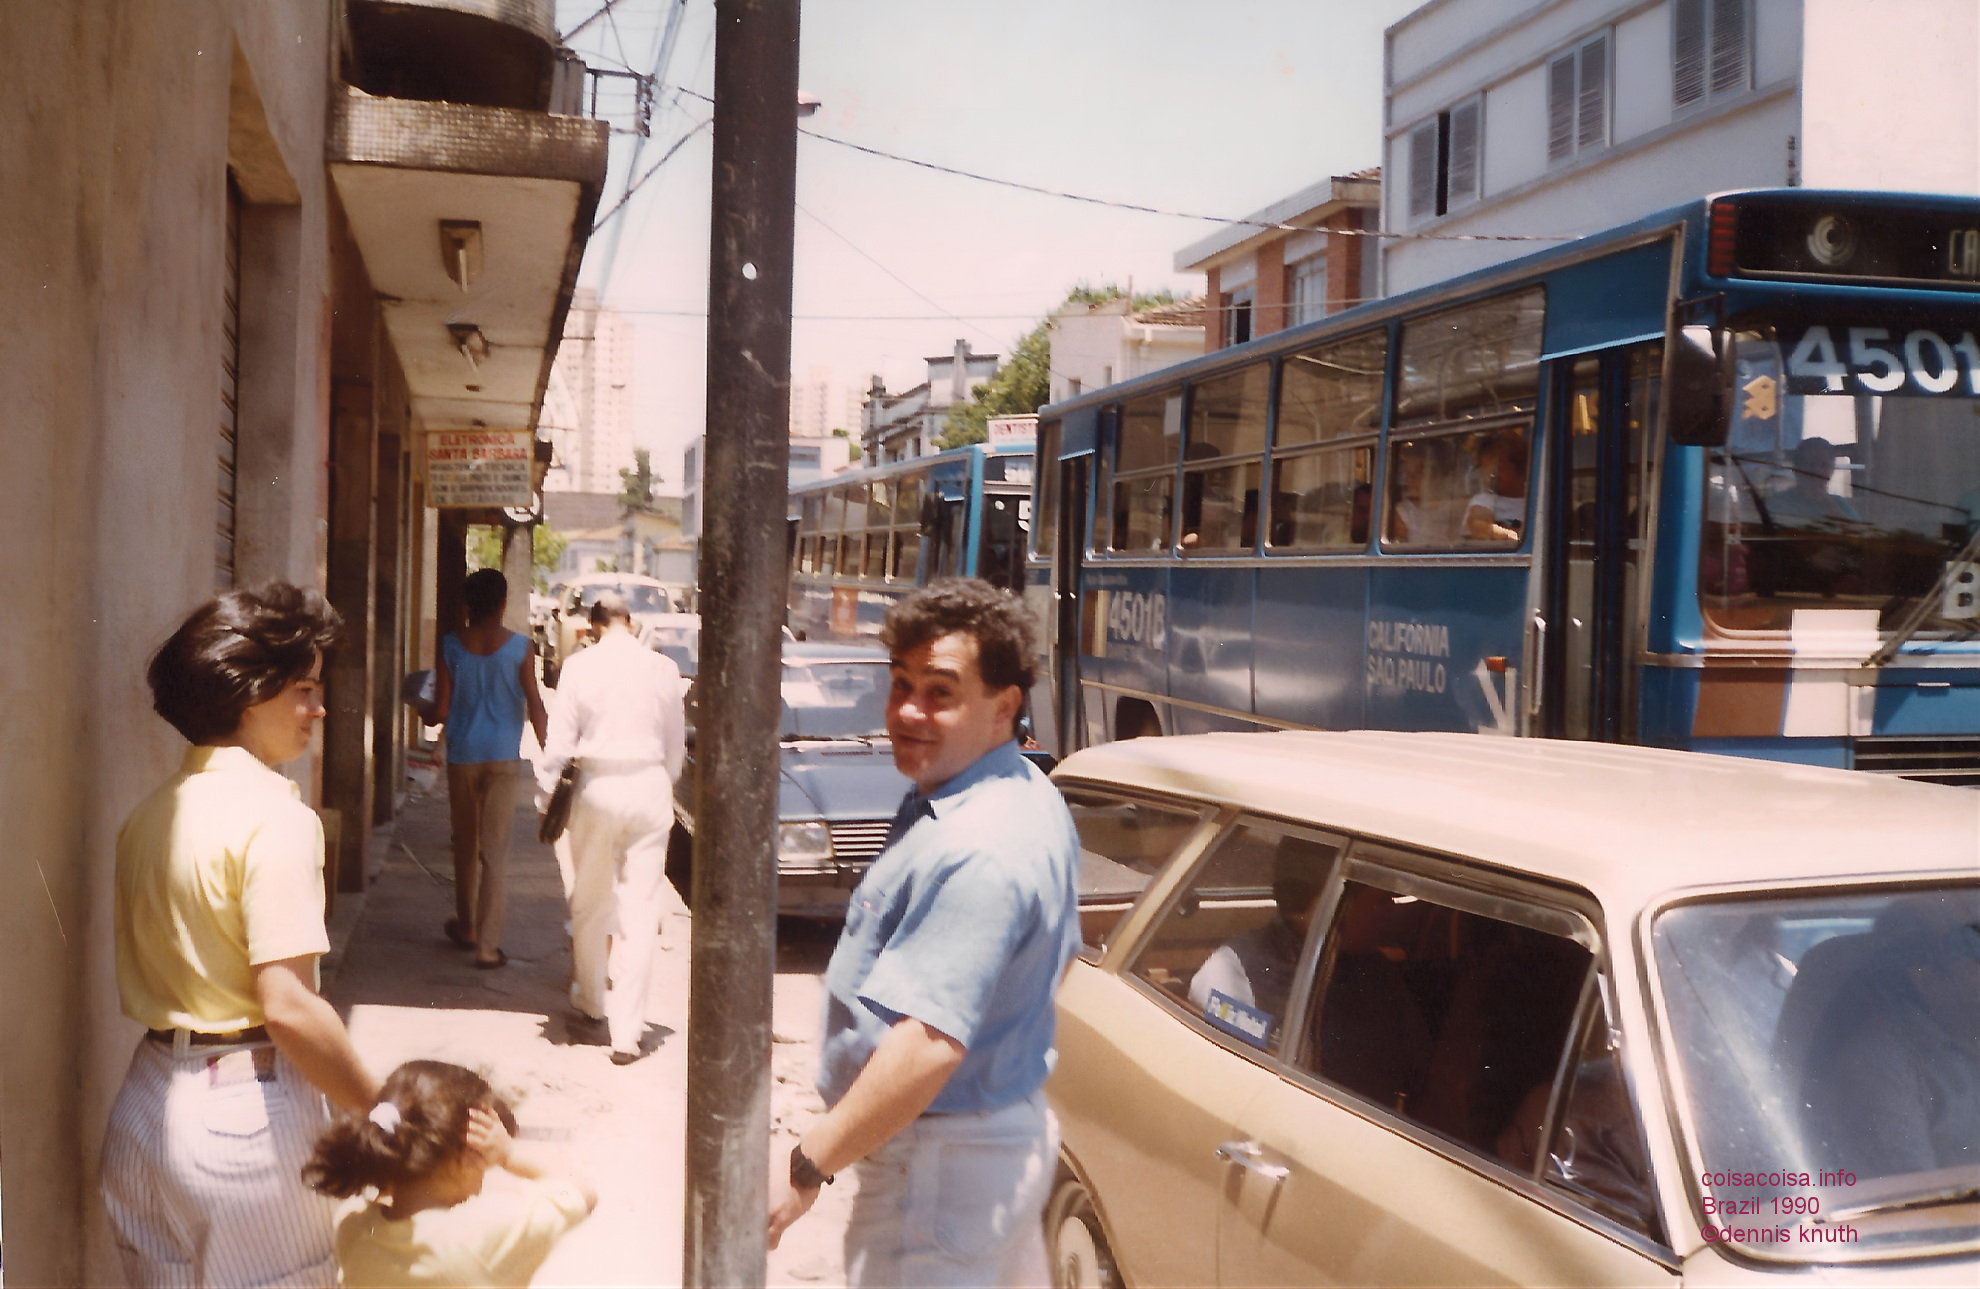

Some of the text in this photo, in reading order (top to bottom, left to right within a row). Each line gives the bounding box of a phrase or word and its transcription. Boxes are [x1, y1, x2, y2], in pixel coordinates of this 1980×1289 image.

[994, 422, 1036, 436] DENTIST
[429, 448, 467, 460] SANTA
[1107, 590, 1167, 650] 4501B
[1399, 657, 1447, 694] PAULO
